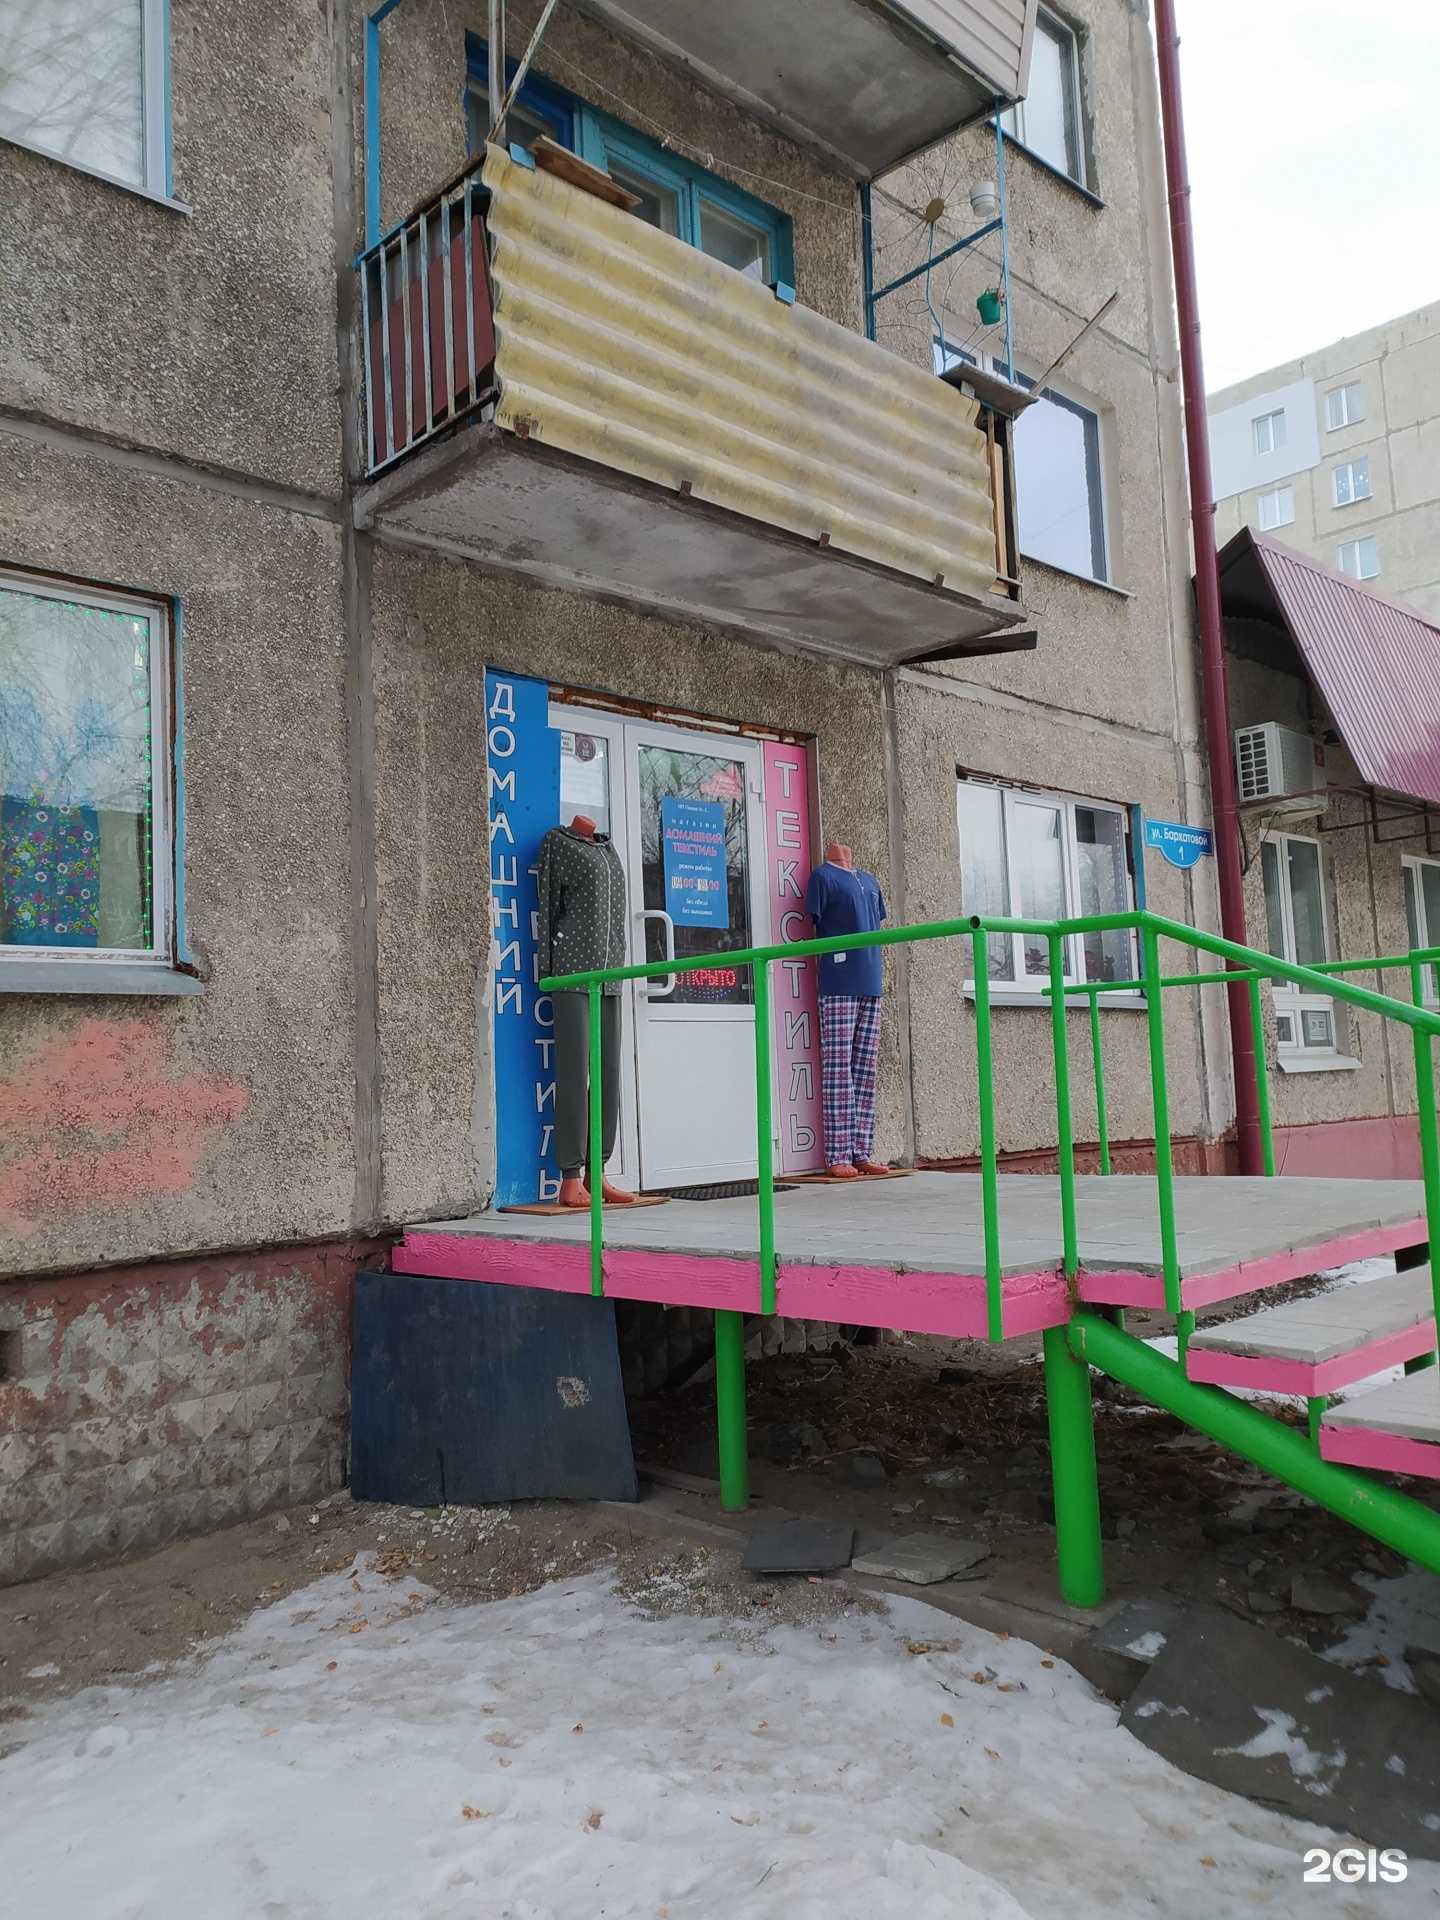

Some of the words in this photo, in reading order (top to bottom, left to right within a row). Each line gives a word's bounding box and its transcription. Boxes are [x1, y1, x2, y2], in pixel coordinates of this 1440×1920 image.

[1151, 828, 1162, 841] ул.
[1163, 827, 1208, 846] Бархатовой
[488, 682, 523, 1015] ДОМАШНИЙ
[672, 842, 718, 857] ТЕКСТИЛЬ
[1179, 846, 1185, 860] 1
[774, 760, 816, 1153] ТЕКСТИЛЬ
